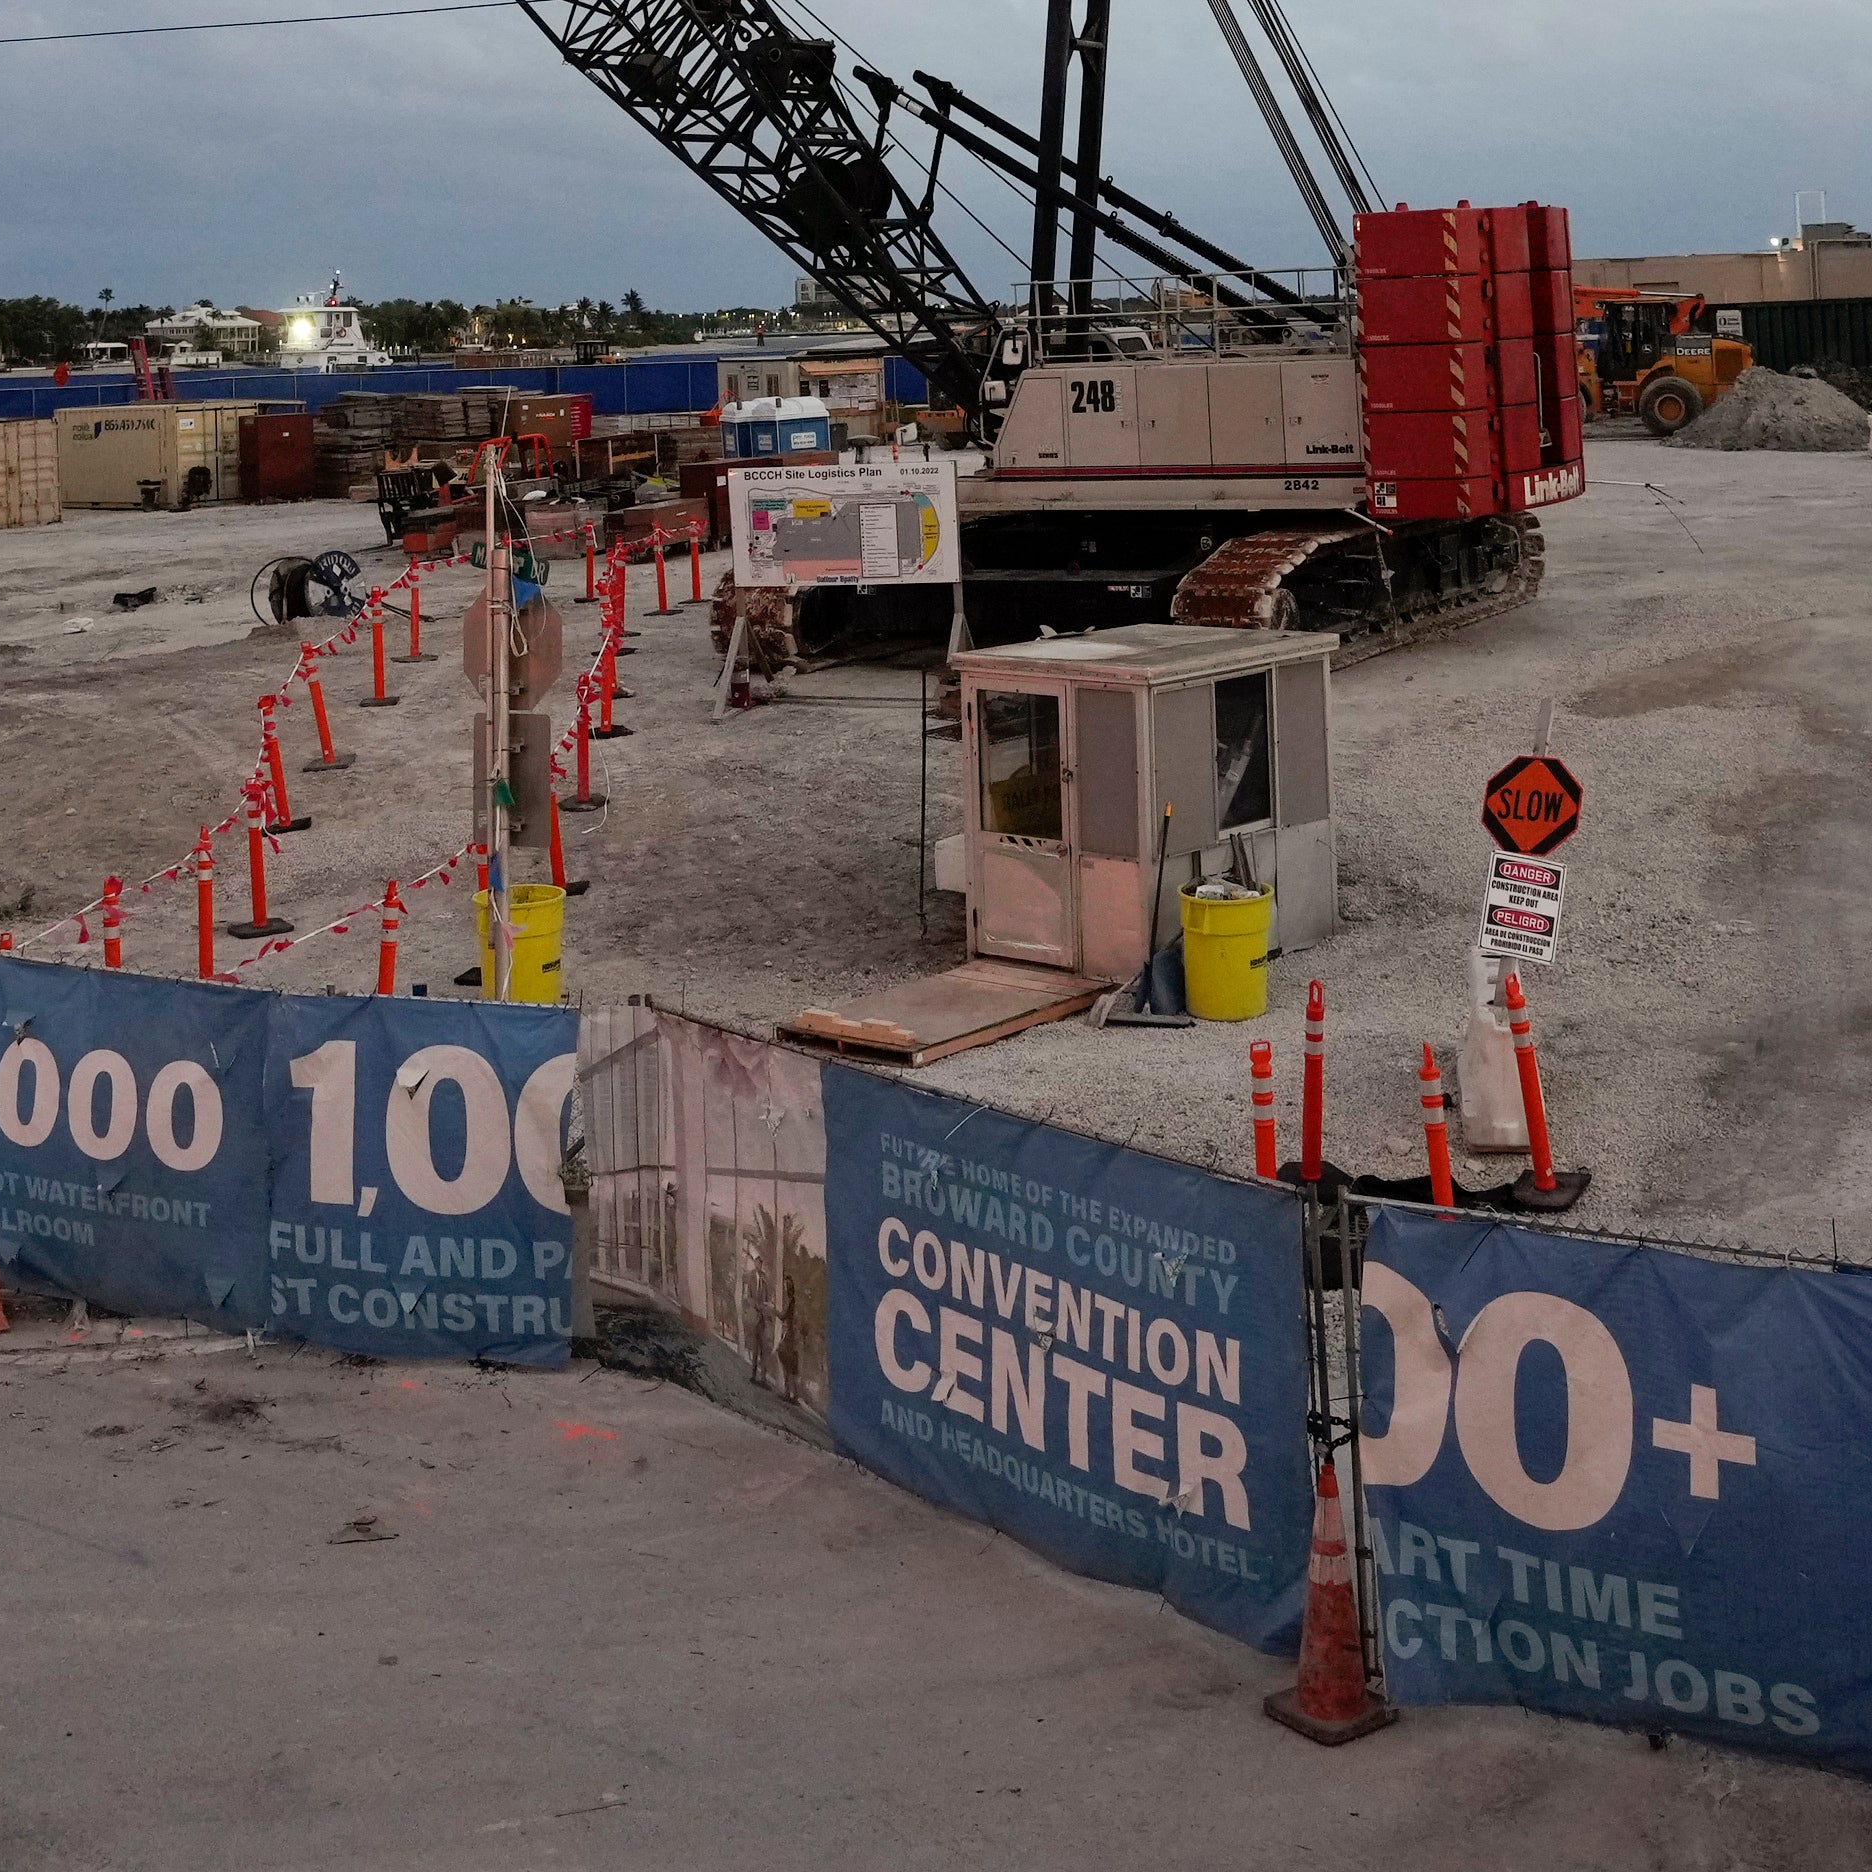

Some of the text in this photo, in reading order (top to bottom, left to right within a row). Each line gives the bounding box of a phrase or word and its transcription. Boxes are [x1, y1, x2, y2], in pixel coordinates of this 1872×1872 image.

[1676, 347, 1712, 356] DEERE
[1071, 380, 1115, 413] 248
[1306, 444, 1354, 455] Link-Belt
[744, 467, 882, 481] BCCCH Site Logistics Plan
[899, 467, 939, 475] 01.10.2022
[1284, 480, 1319, 491] 2842
[1524, 465, 1580, 506] Link-Belt
[1497, 788, 1565, 824] SLOW
[1491, 879, 1559, 902] CONSTRUCTION AREA
[1503, 863, 1551, 884] DANGER
[1508, 894, 1539, 909] KEEP OUT
[1496, 910, 1545, 930] PELIGRO
[1529, 945, 1544, 957] PASO
[24, 1175, 211, 1228] WATERFRONT
[880, 1131, 1237, 1267] FUTURE HOME OF THE EXPANDED
[269, 1219, 388, 1274] FULL
[399, 1234, 518, 1280] AND
[881, 1160, 1238, 1315] BROWARD COUNTY
[878, 1216, 1241, 1406] CONVENTION
[874, 1288, 1251, 1532] CENTER
[881, 1399, 1261, 1582] AND HEADQUARTERS HOTEL
[1495, 1546, 1684, 1641] TIME
[1385, 1598, 1821, 1737] CTION JOBS
